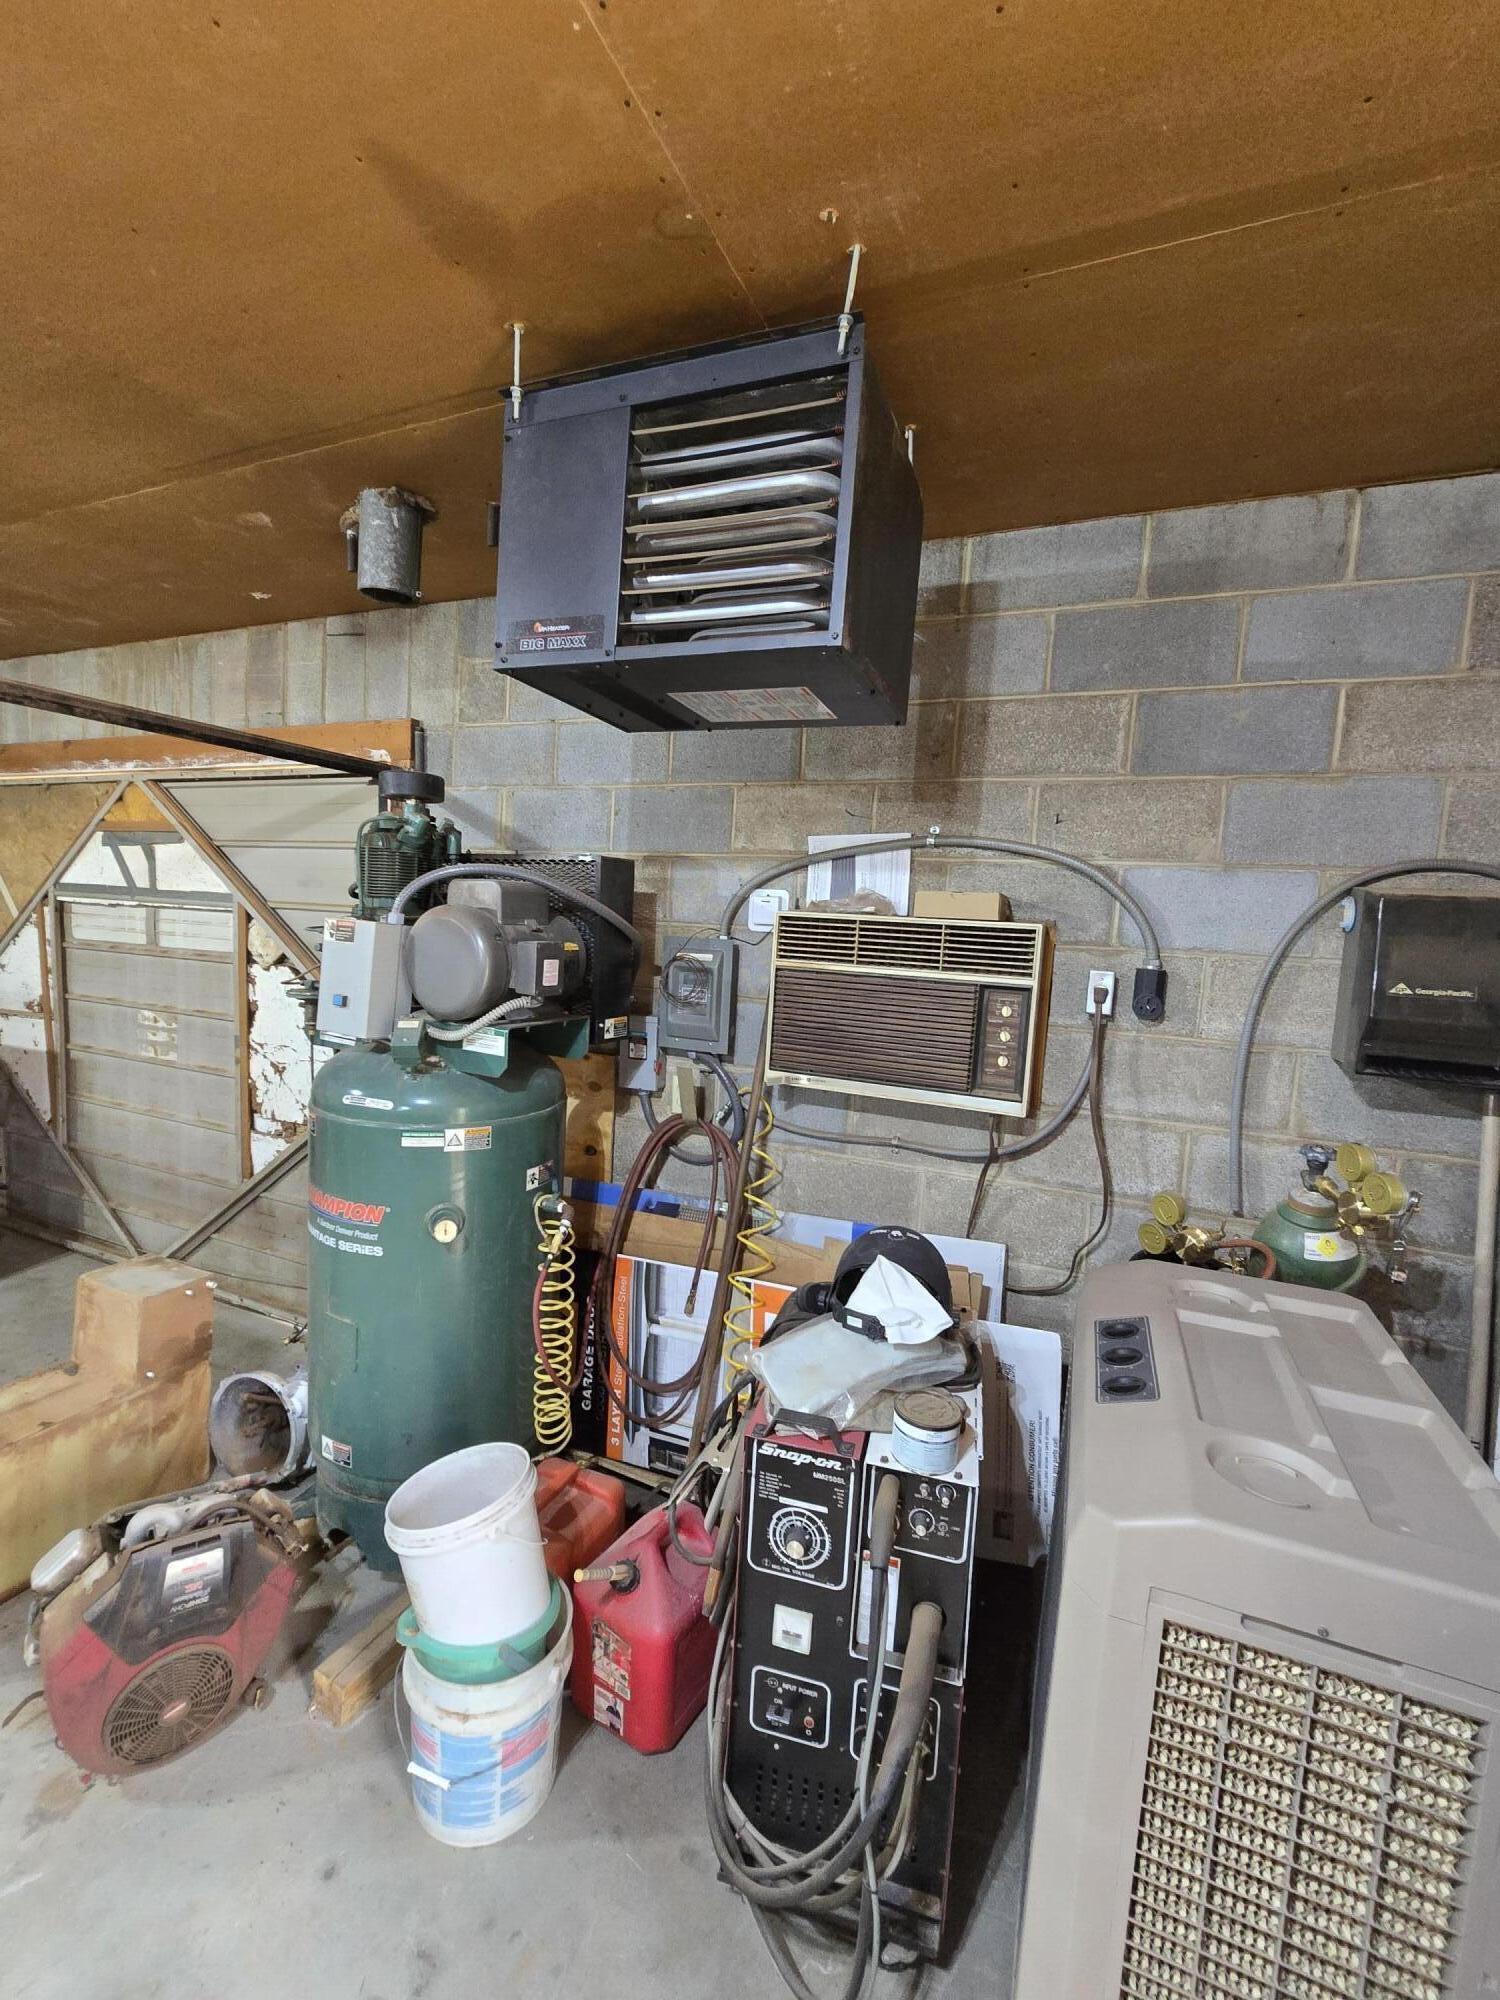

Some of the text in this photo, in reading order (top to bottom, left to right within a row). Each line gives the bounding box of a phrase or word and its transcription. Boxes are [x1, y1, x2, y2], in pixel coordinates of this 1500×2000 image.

[520, 634, 587, 650] BIG MAXX
[354, 1230, 379, 1241] Product
[581, 1346, 595, 1411] GARAGE
[611, 1437, 620, 1447] 3
[758, 1442, 843, 1470] Snap-on
[798, 1687, 818, 1699] POWER
